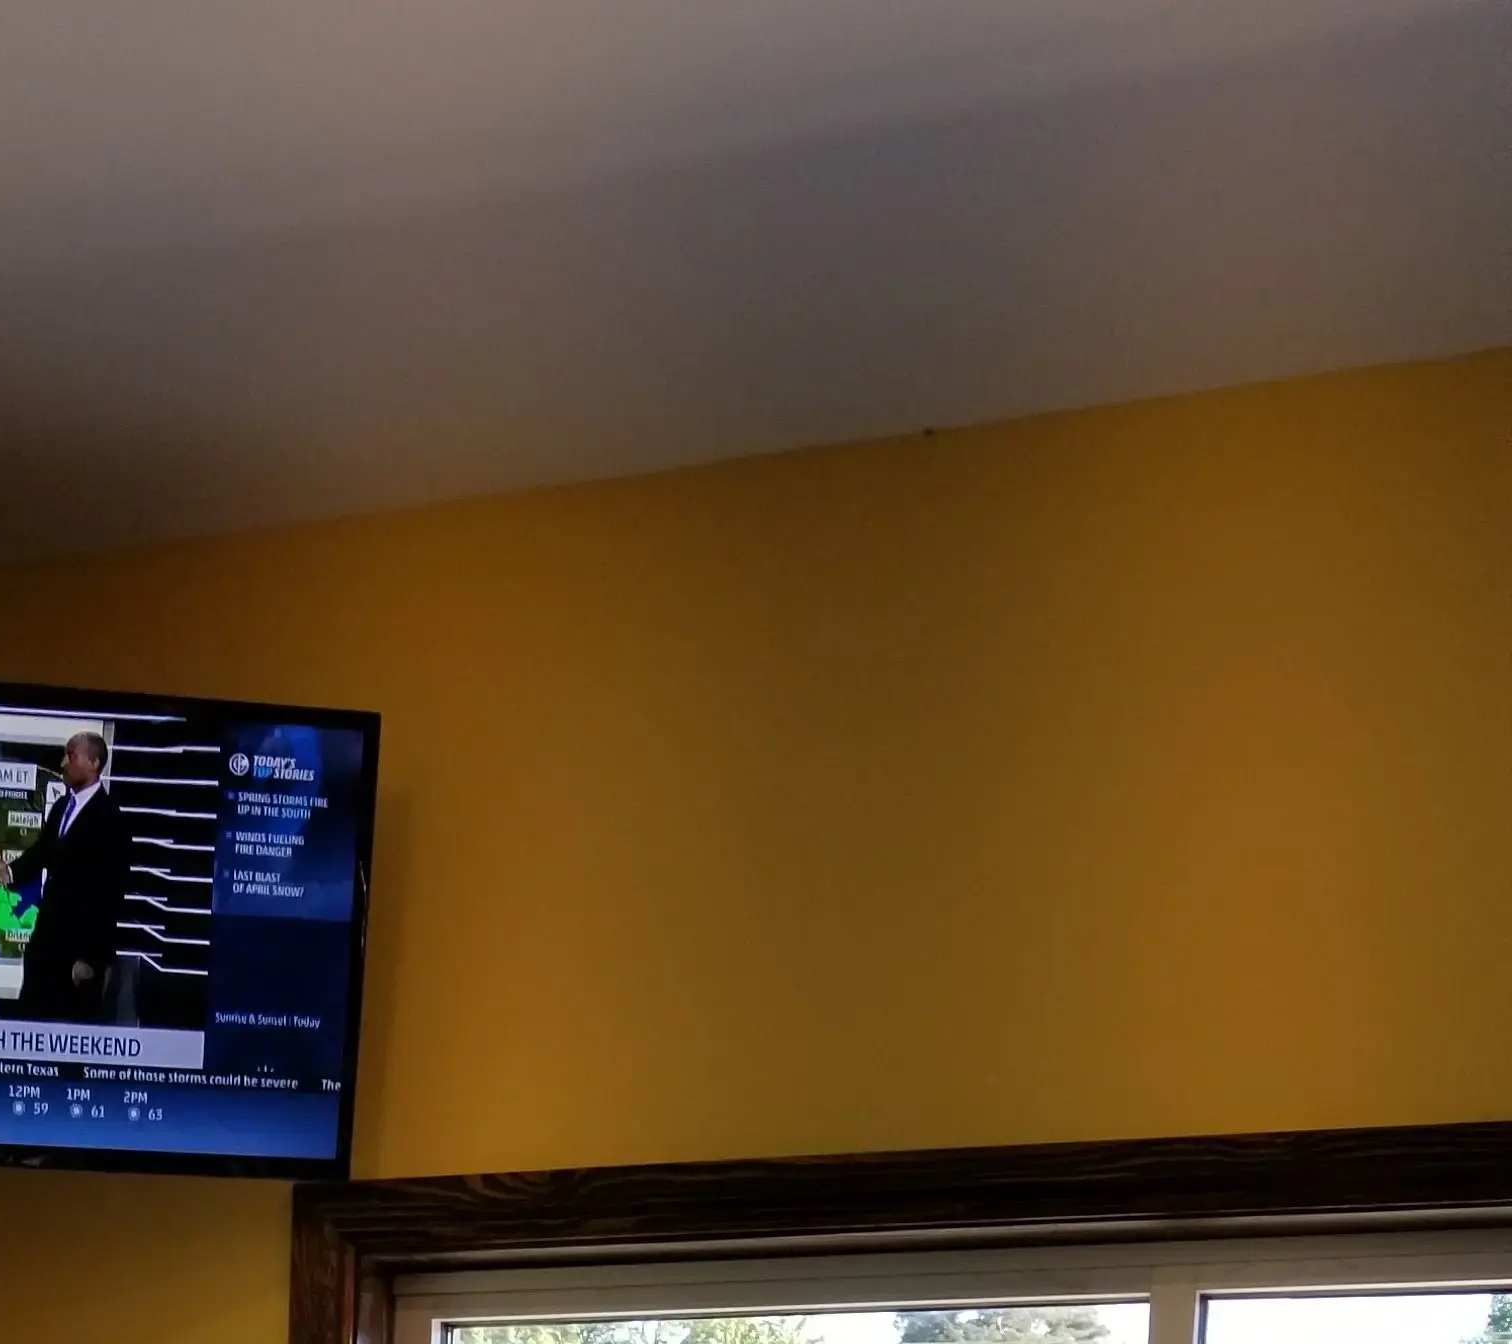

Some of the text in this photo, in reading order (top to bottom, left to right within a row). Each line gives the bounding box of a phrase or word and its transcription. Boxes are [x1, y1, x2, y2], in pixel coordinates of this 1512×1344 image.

[253, 754, 297, 769] TODAY'S
[15, 769, 29, 784] ET
[252, 766, 315, 781] TOP STORIES
[238, 791, 329, 808] SPRING STORMS FIRE
[237, 804, 311, 820] UP IN THE SOUTH
[235, 830, 305, 845] WINDS FUELING
[235, 843, 293, 858] FIRE DANGER
[233, 868, 281, 882] LAST BLAST
[233, 882, 305, 898] OF APRIL SNOW?
[293, 1015, 321, 1029] Today
[10, 1031, 45, 1053] THE
[49, 1033, 142, 1058] WEEKEND
[26, 1063, 60, 1077] Texas
[82, 1066, 299, 1089] Some of those storms could be severe
[8, 1085, 40, 1099] 12PM
[321, 1078, 342, 1092] The
[66, 1088, 91, 1101] 1PM
[123, 1090, 148, 1104] 2PM
[33, 1102, 49, 1116] 59
[91, 1105, 105, 1119] 61
